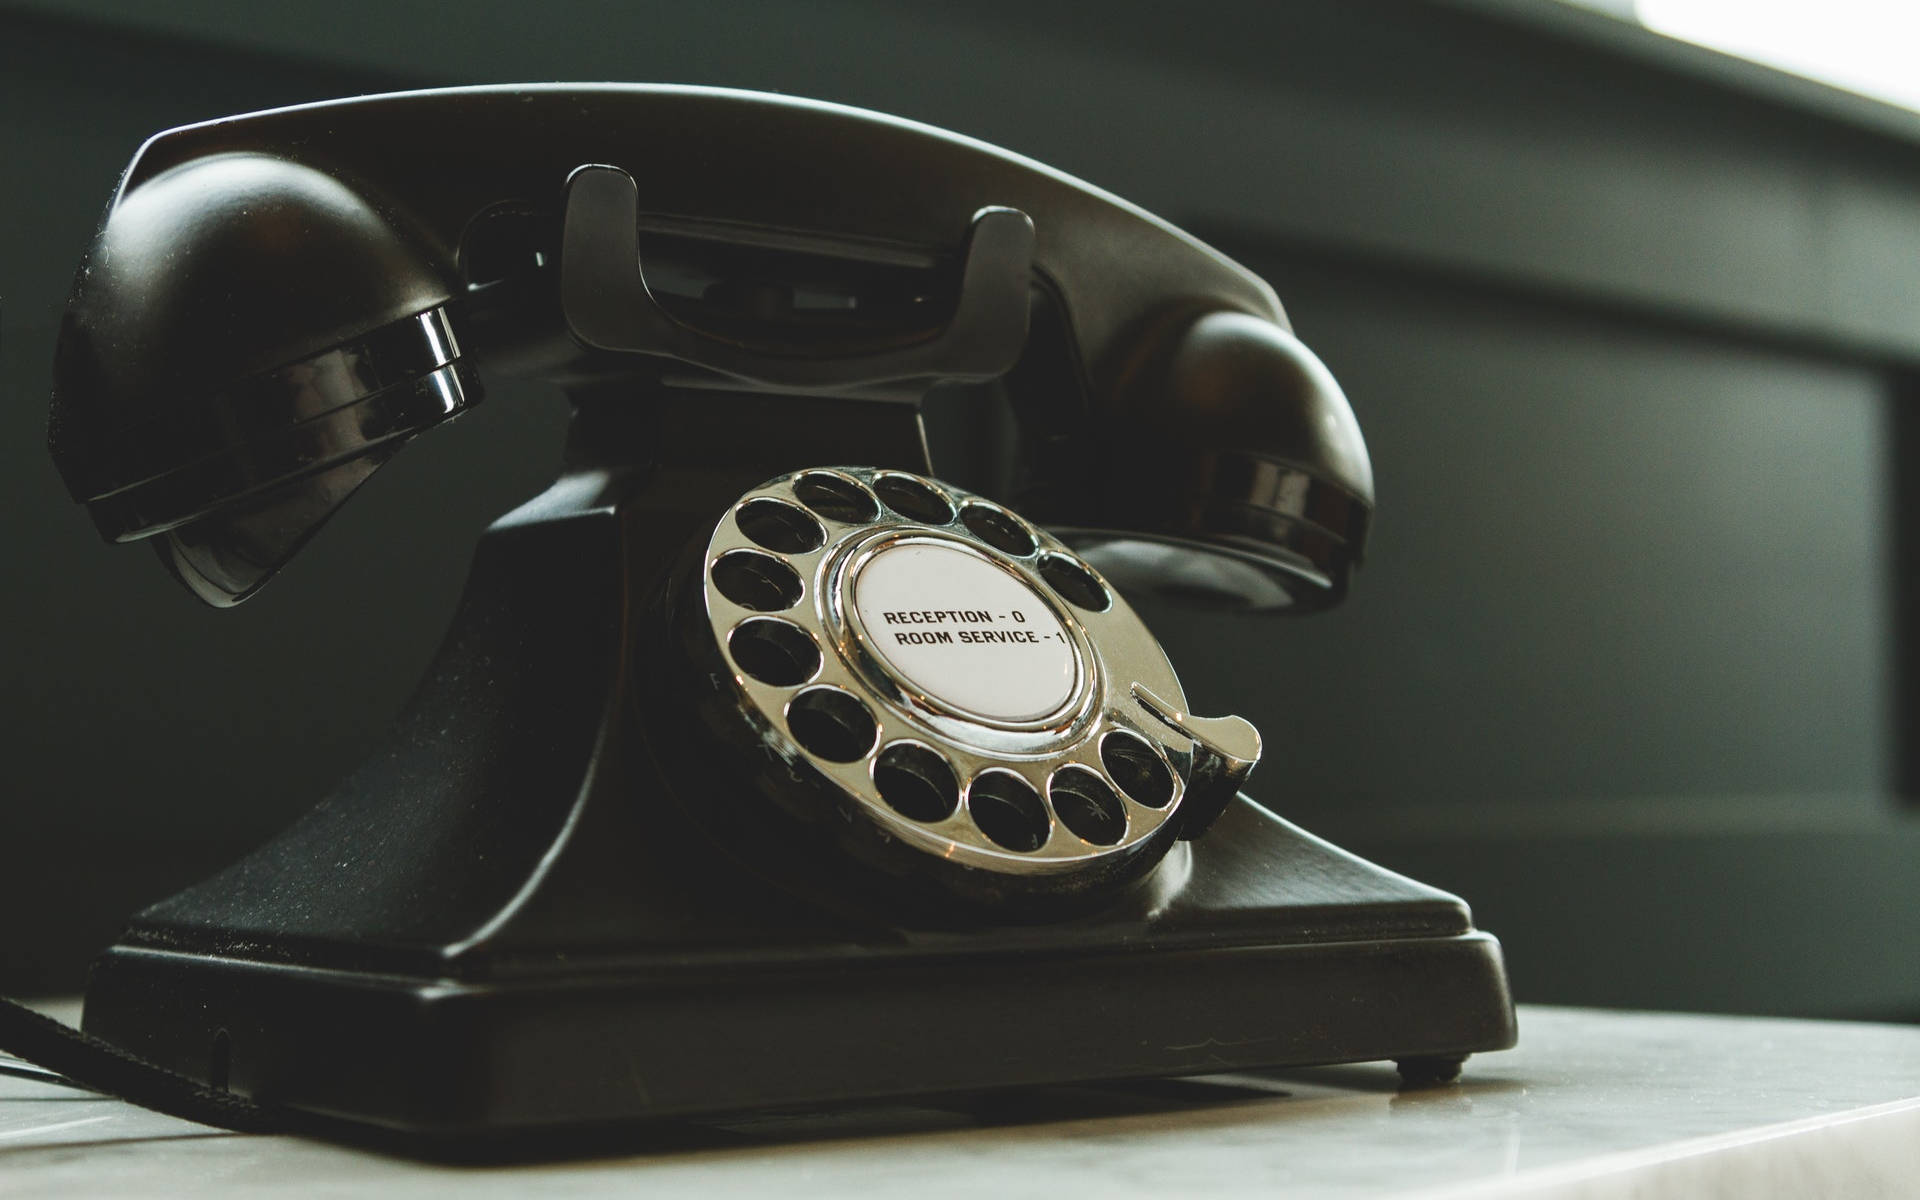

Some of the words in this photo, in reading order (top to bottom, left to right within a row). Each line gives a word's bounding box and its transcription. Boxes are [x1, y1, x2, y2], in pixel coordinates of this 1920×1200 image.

[883, 610, 993, 625] RECEPTION
[894, 631, 954, 646] ROOM
[957, 630, 1040, 644] SERVICE
[1055, 631, 1066, 644] 1
